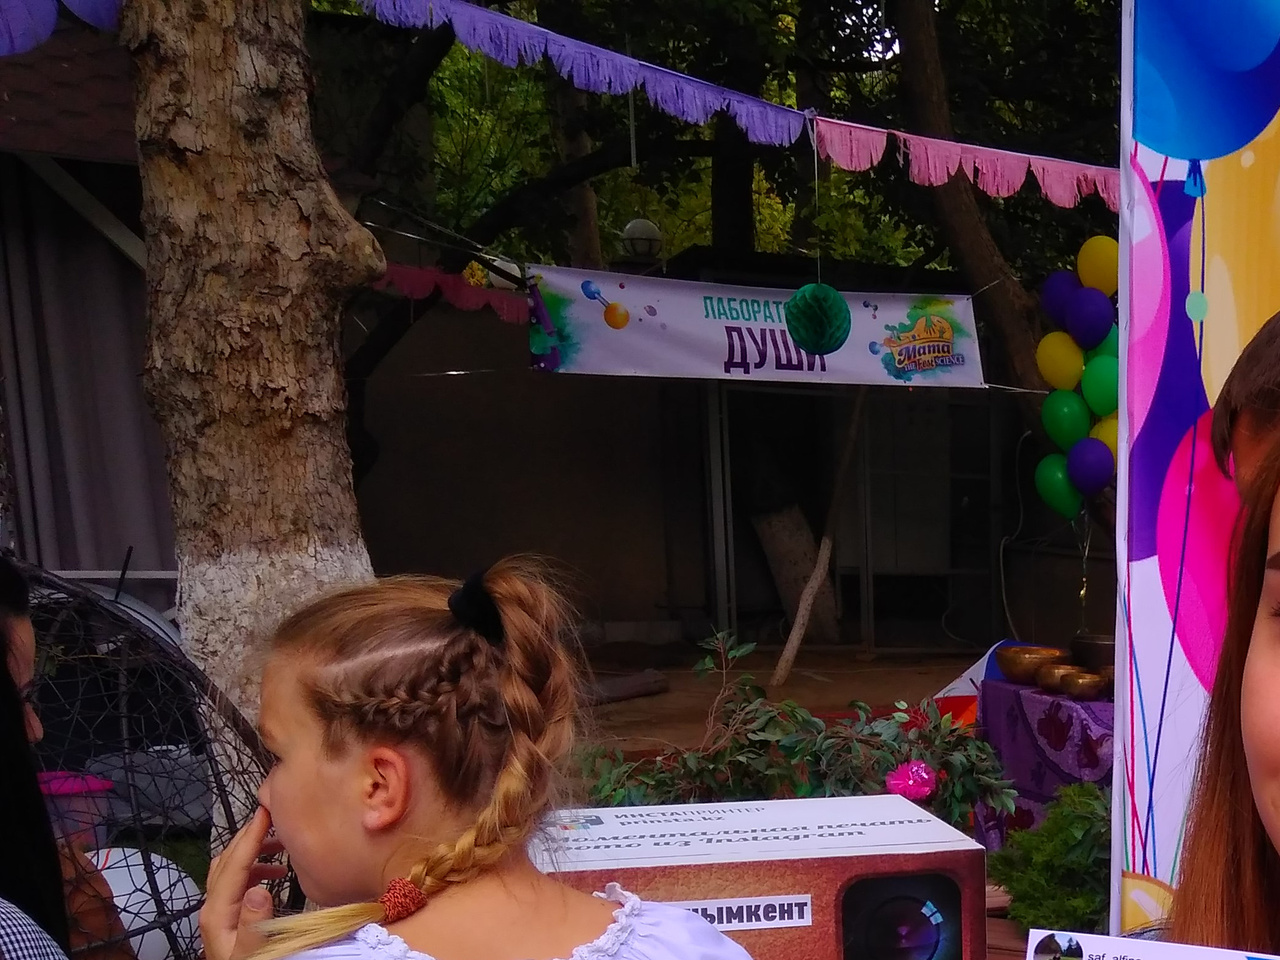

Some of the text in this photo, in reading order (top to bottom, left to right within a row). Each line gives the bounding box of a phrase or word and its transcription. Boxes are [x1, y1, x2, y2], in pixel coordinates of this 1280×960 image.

[703, 295, 787, 324] ЛАБОРАТ
[935, 355, 965, 366] SCIENCE
[614, 807, 765, 819] ИНСТАПРИНТЕР
[619, 816, 726, 826] prinsta.kz
[817, 819, 932, 830] печать
[699, 831, 866, 844] Instagram
[684, 902, 808, 925] ымкент
